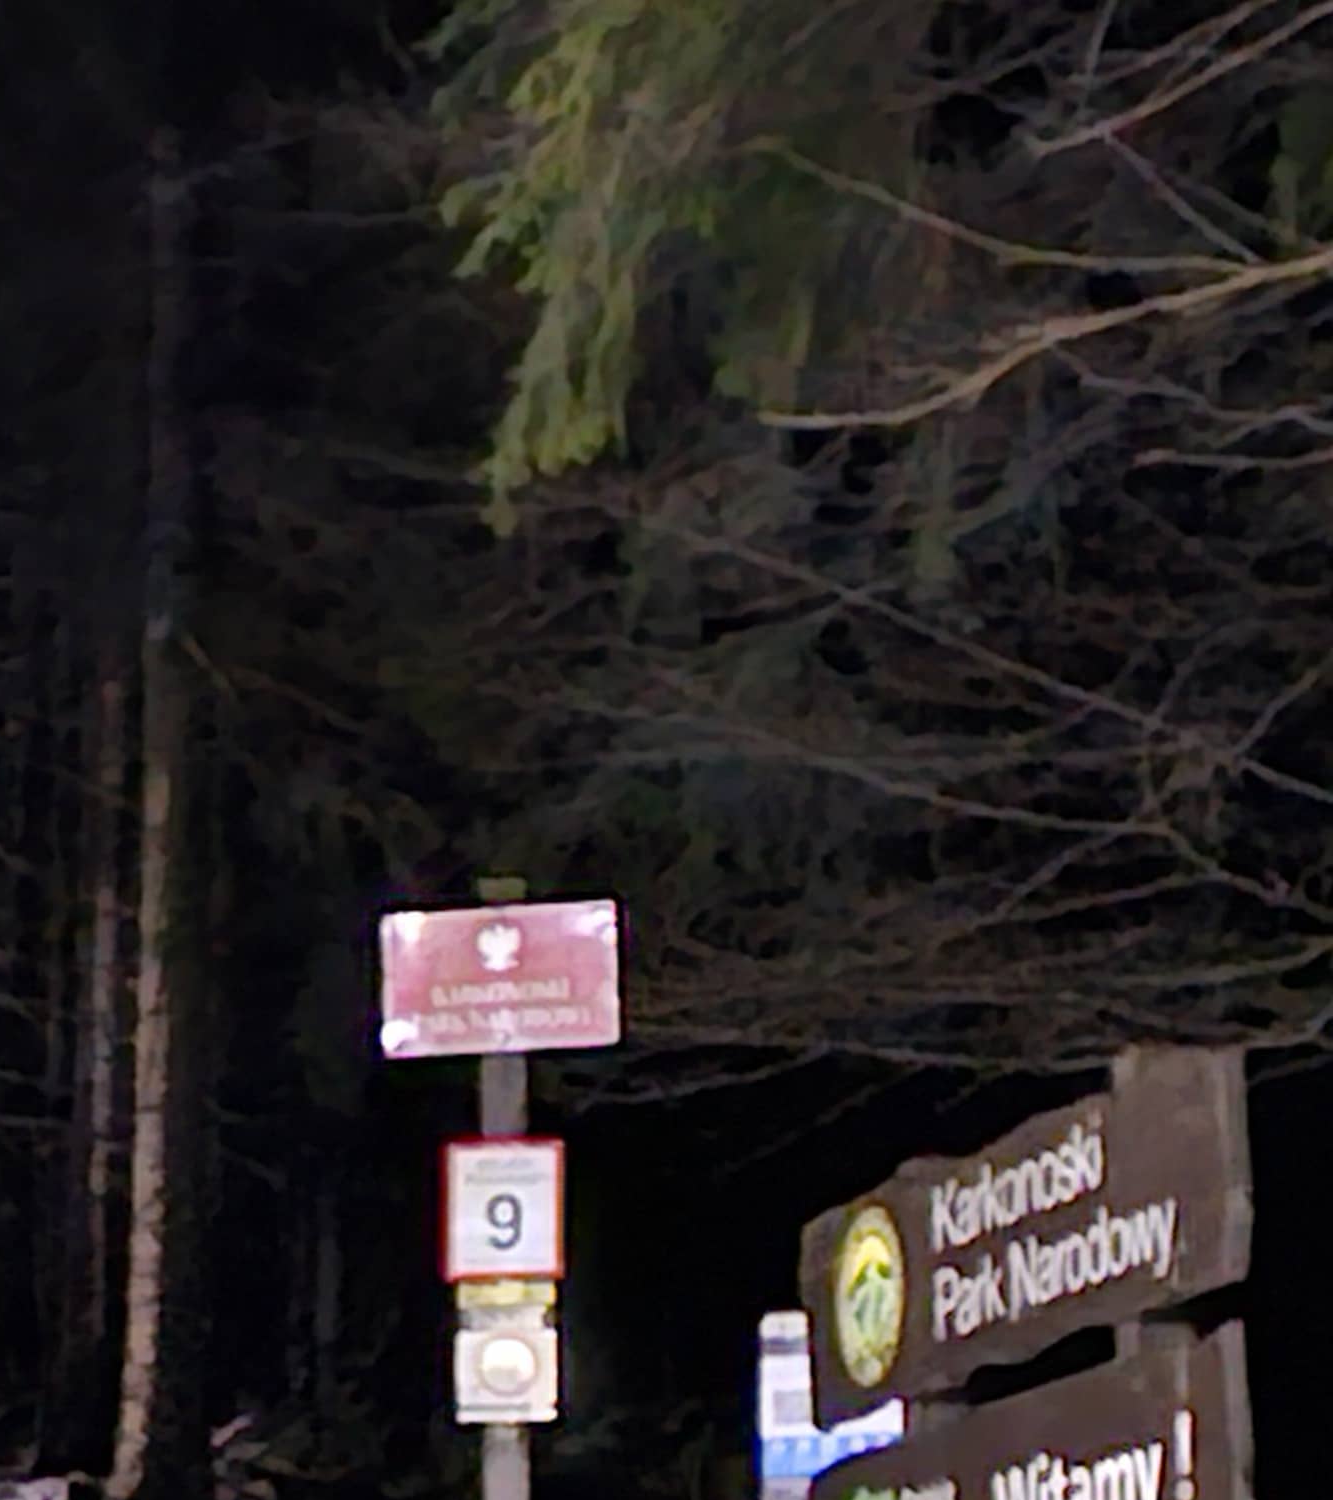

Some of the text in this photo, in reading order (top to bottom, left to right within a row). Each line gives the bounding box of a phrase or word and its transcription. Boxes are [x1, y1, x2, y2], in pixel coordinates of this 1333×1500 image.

[486, 1193, 522, 1250] 9
[930, 1110, 1104, 1251] Karkonoski
[933, 1199, 1177, 1341] Park Narodowy
